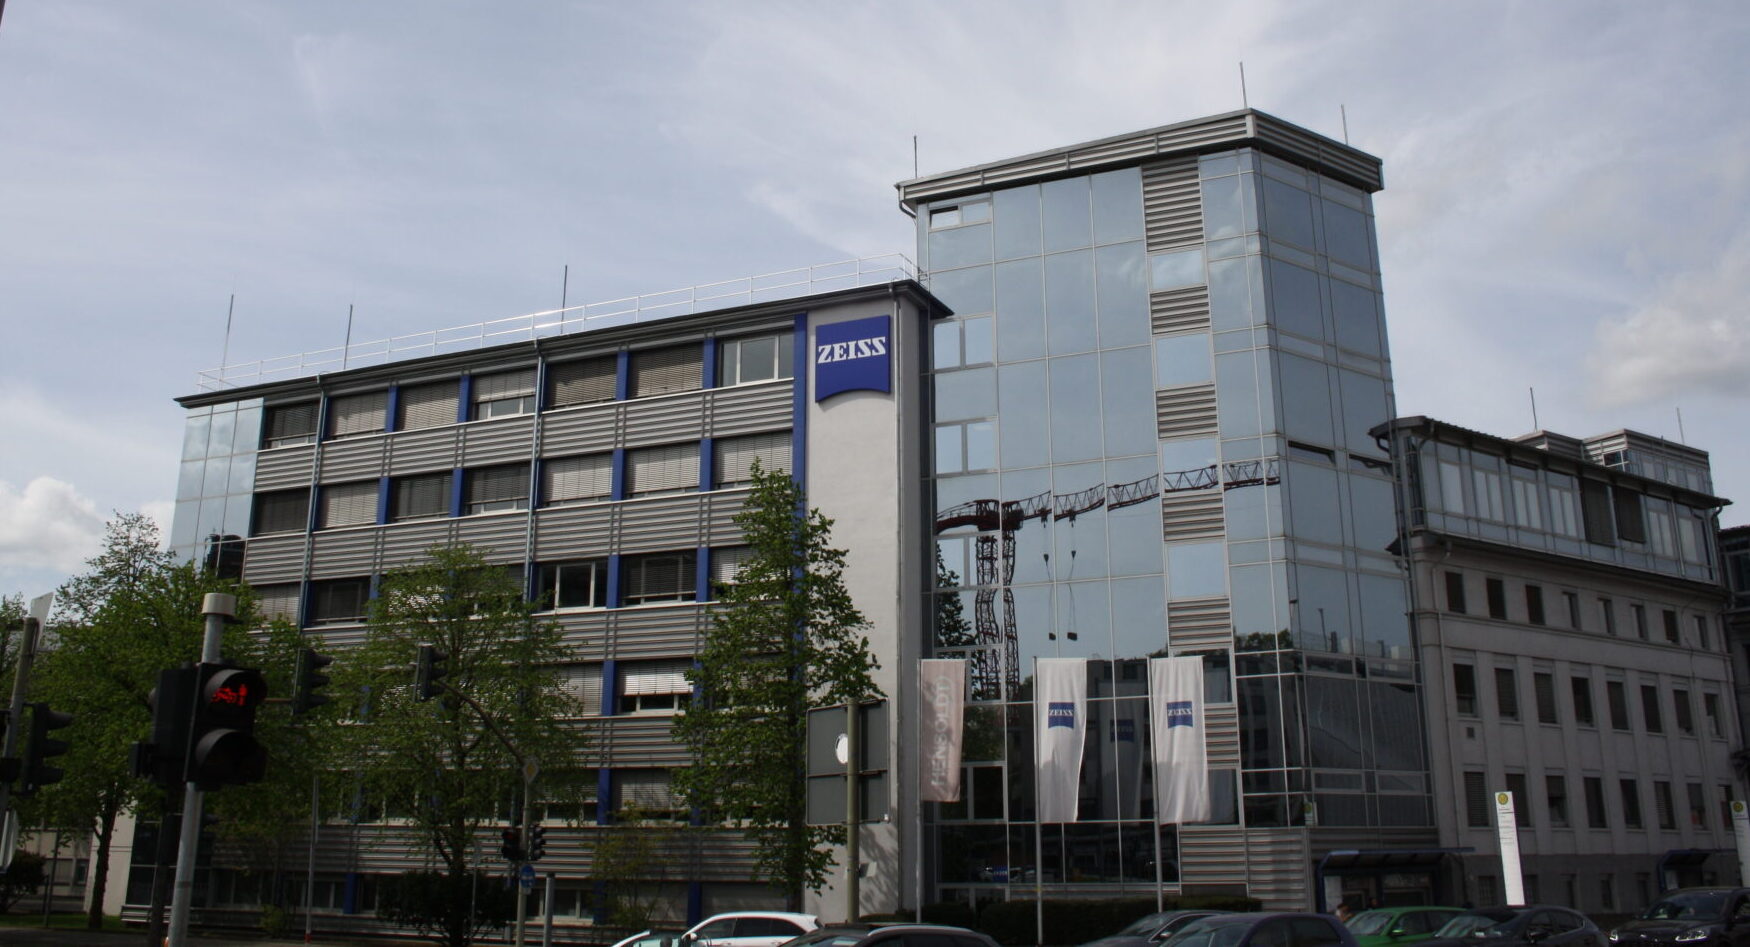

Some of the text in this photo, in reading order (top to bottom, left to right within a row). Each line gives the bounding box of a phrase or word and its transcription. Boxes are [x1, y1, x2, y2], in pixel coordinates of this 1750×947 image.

[817, 336, 886, 364] ZEISS
[1048, 709, 1074, 717] ZEISS
[1167, 708, 1192, 717] ZEISS
[931, 678, 953, 787] HENSOLDT
